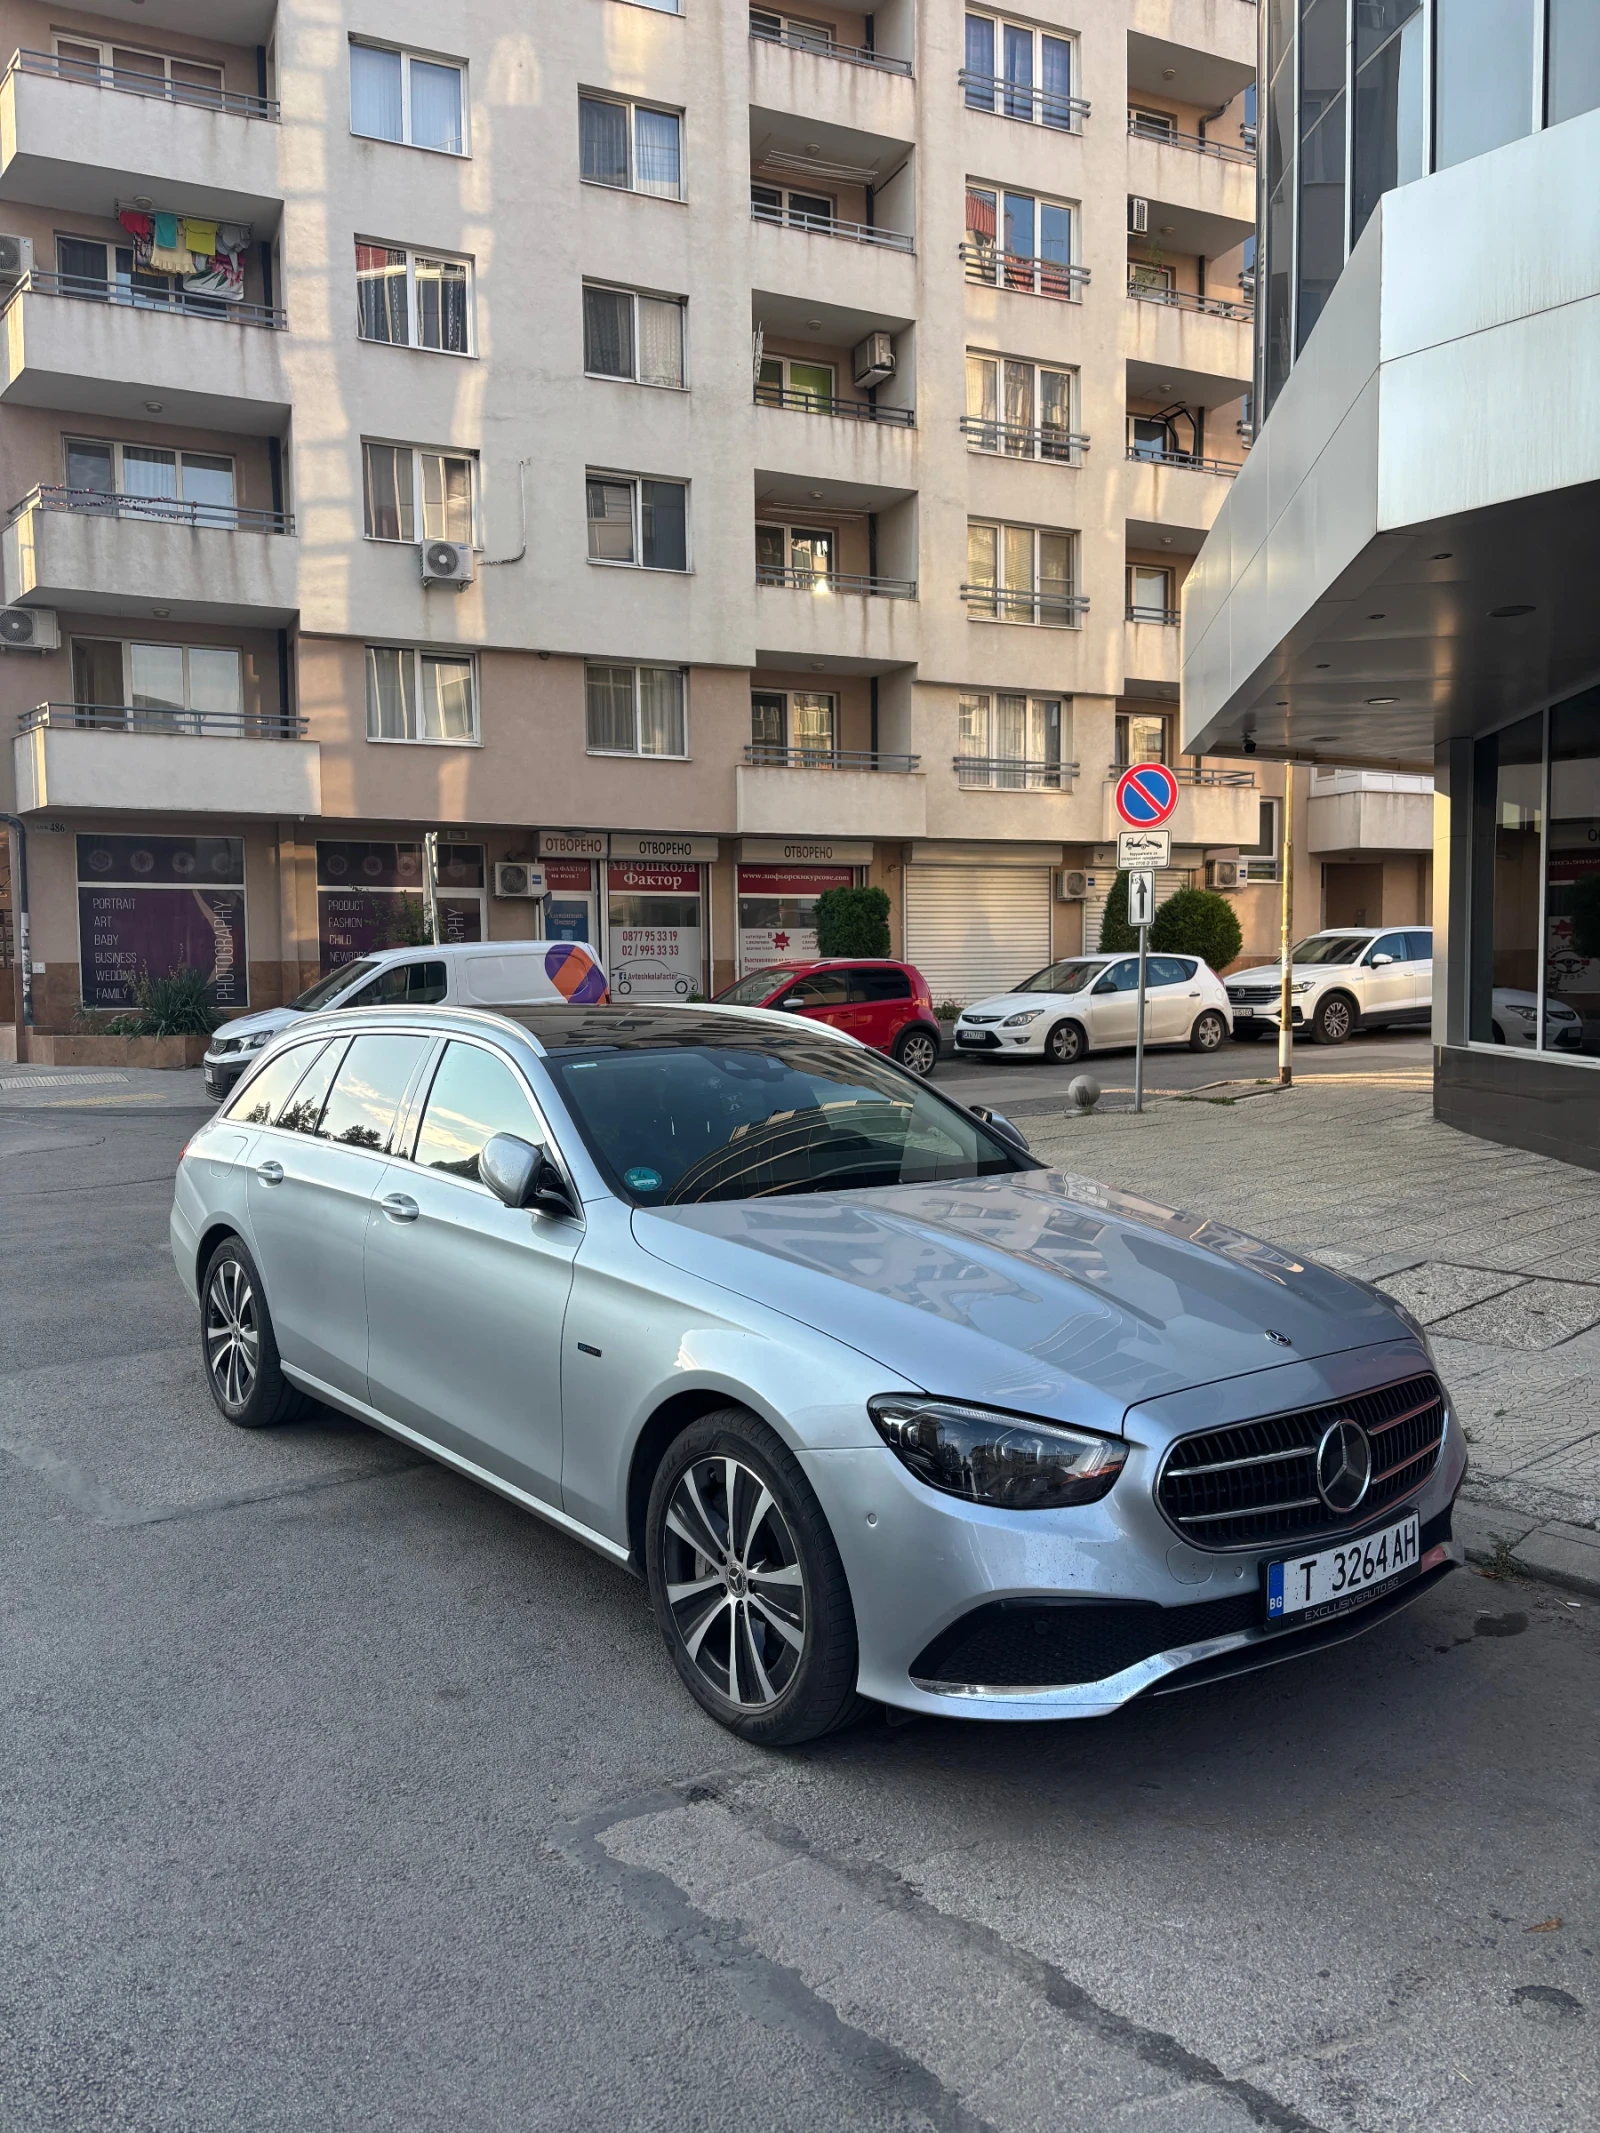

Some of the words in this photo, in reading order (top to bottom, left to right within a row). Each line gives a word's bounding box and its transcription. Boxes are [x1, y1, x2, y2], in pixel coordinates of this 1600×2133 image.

[545, 837, 602, 853] ОТВОРЕНО
[639, 841, 692, 856] ОТВОРЕНО
[784, 845, 833, 859] ОТВОРЕНО
[608, 860, 696, 873] Автошкола
[623, 871, 682, 890] Фактор
[93, 898, 136, 910] PORTRAIT
[328, 900, 364, 911] PRODUCT
[94, 916, 112, 927] ART
[328, 917, 363, 928] FASHION
[94, 934, 119, 946] BABY
[329, 934, 352, 945] CHILD
[622, 931, 643, 942] 0877
[644, 931, 655, 942] 95
[656, 931, 667, 942] 33
[669, 931, 678, 942] 19
[213, 900, 235, 1000] PHOTOGRAPHY
[622, 945, 633, 956] 02
[640, 945, 655, 956] 995
[656, 945, 667, 956] 33
[668, 945, 679, 956] 33
[95, 952, 137, 964] BUSINESS
[96, 987, 128, 999] FAMILY
[1300, 1560, 1317, 1601] T
[1332, 1535, 1387, 1591] 3264
[1392, 1520, 1417, 1568] AH
[1269, 1596, 1283, 1610] BG
